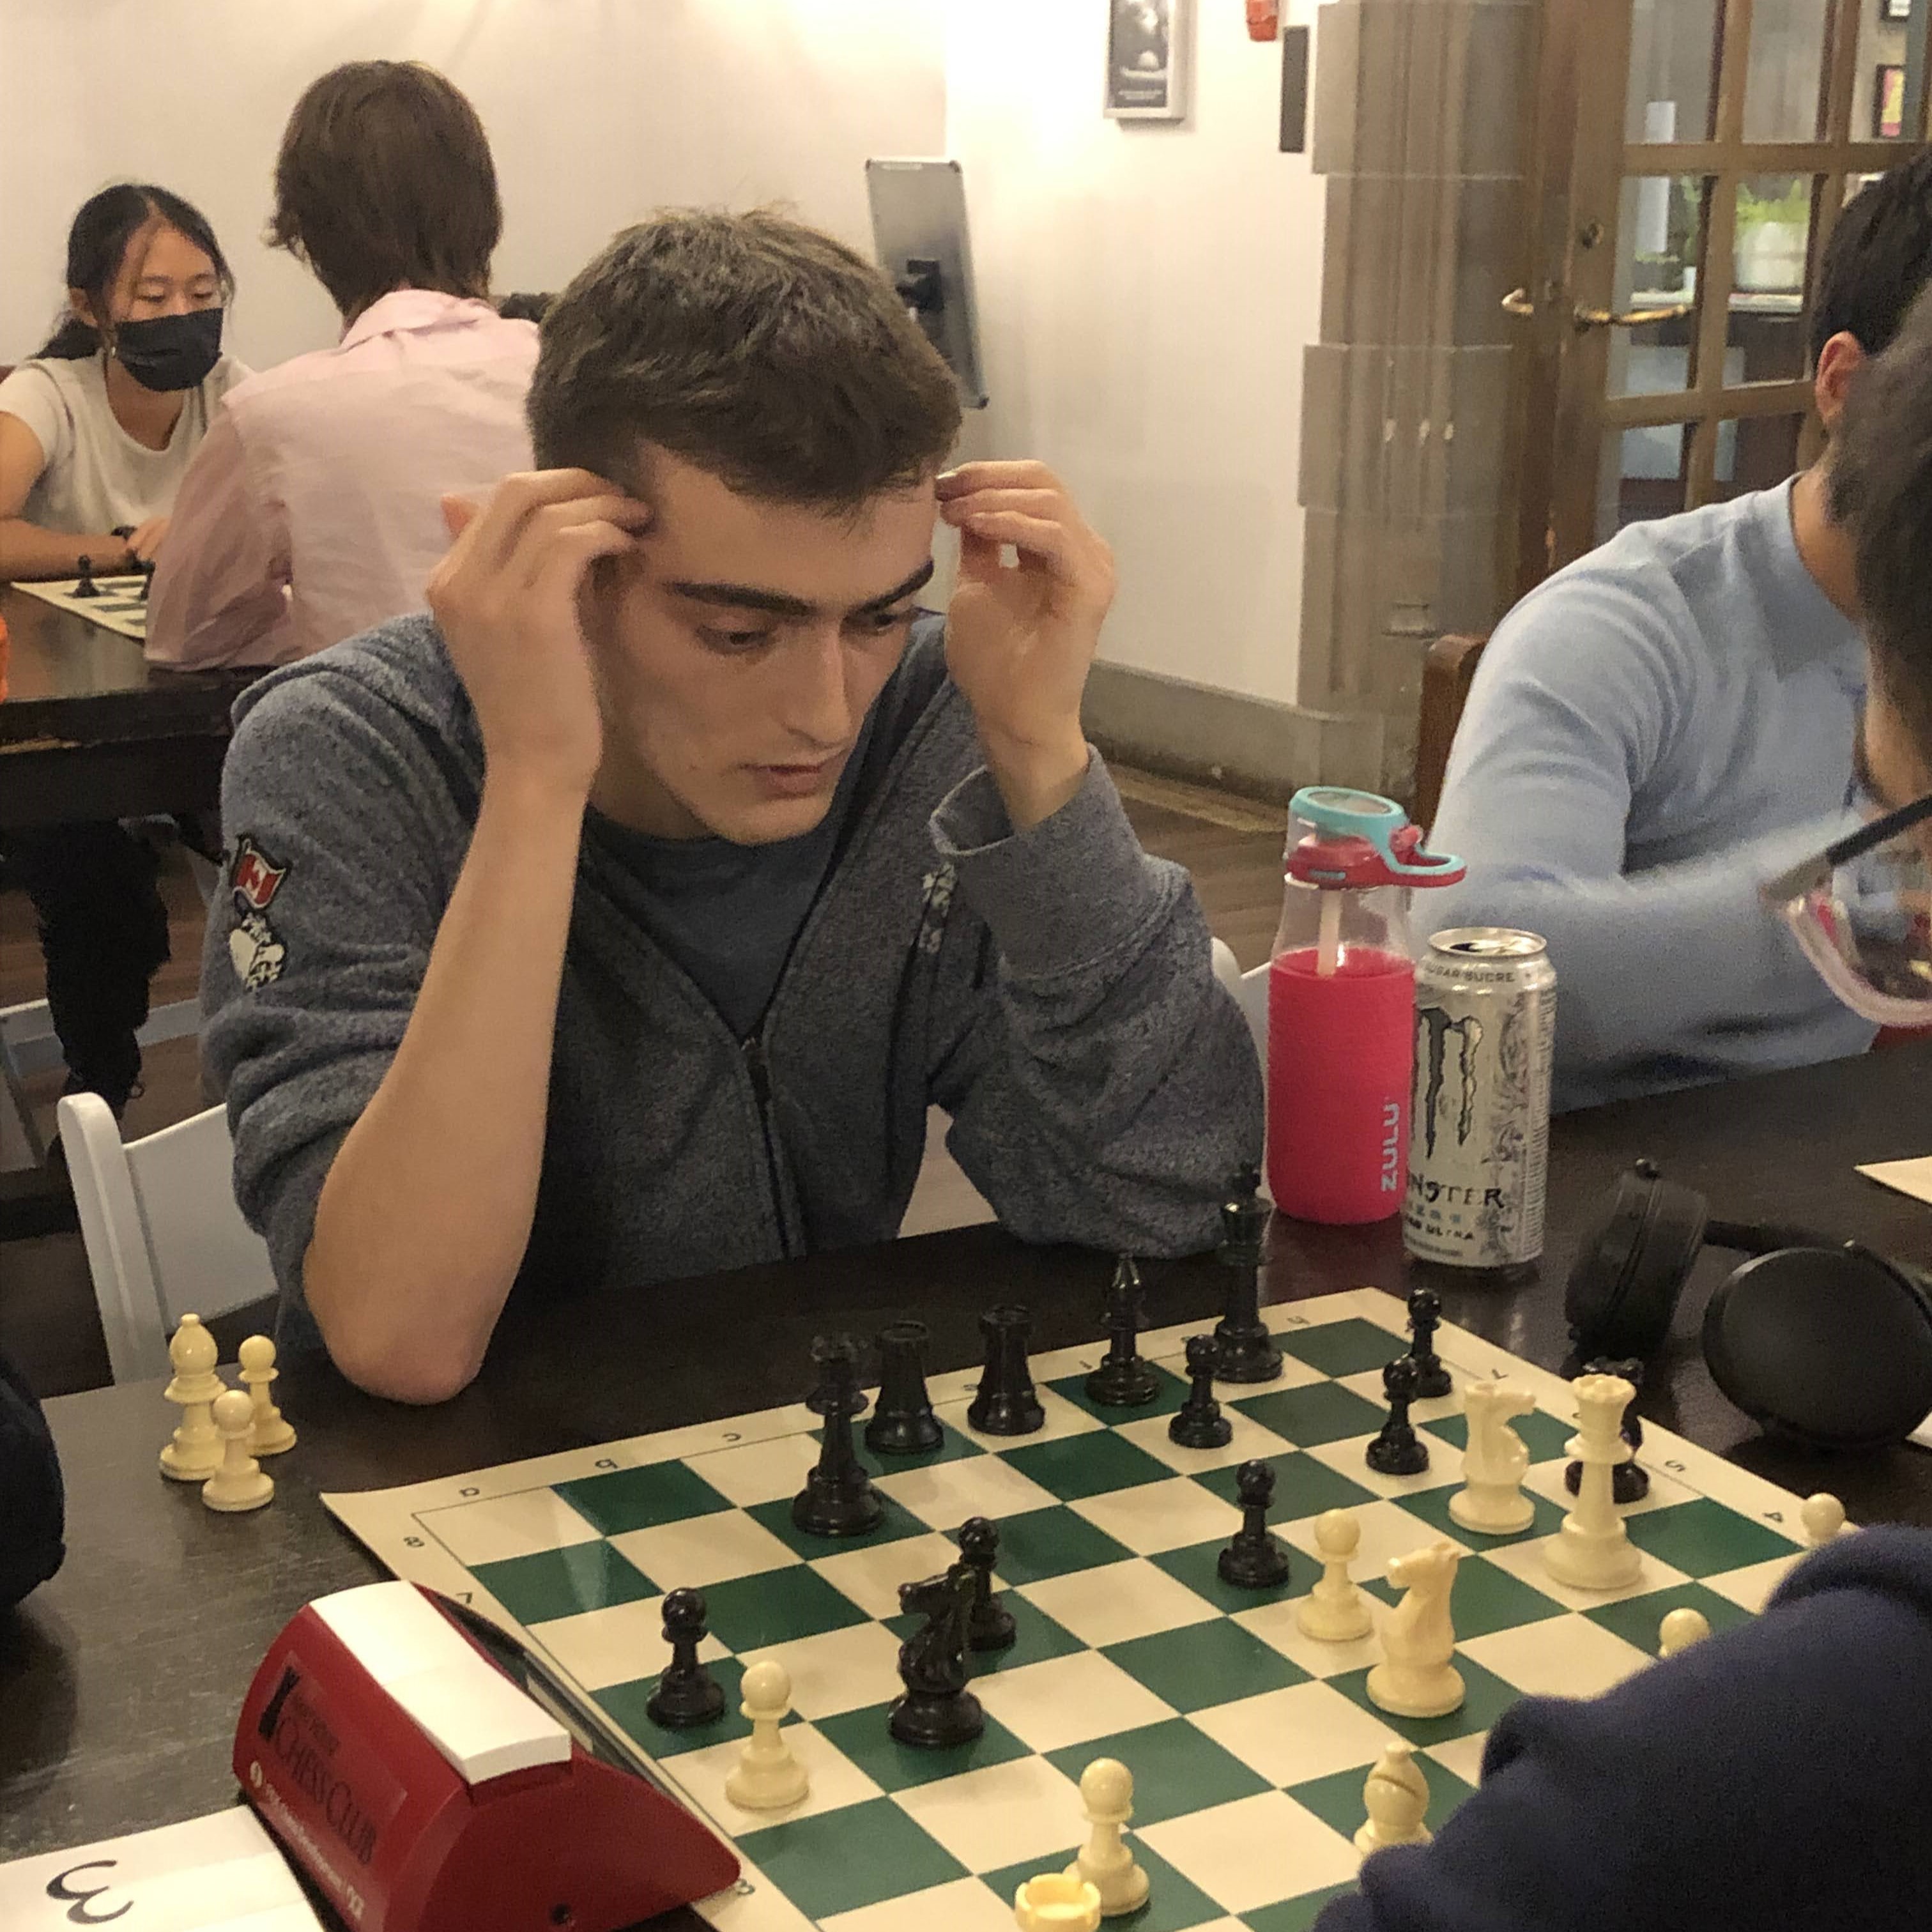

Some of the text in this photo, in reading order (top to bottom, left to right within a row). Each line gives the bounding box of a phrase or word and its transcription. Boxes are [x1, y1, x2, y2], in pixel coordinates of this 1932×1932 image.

[1381, 1103, 1400, 1192] ZULU
[1410, 1173, 1504, 1208] NSTER
[456, 1591, 473, 1604] 7
